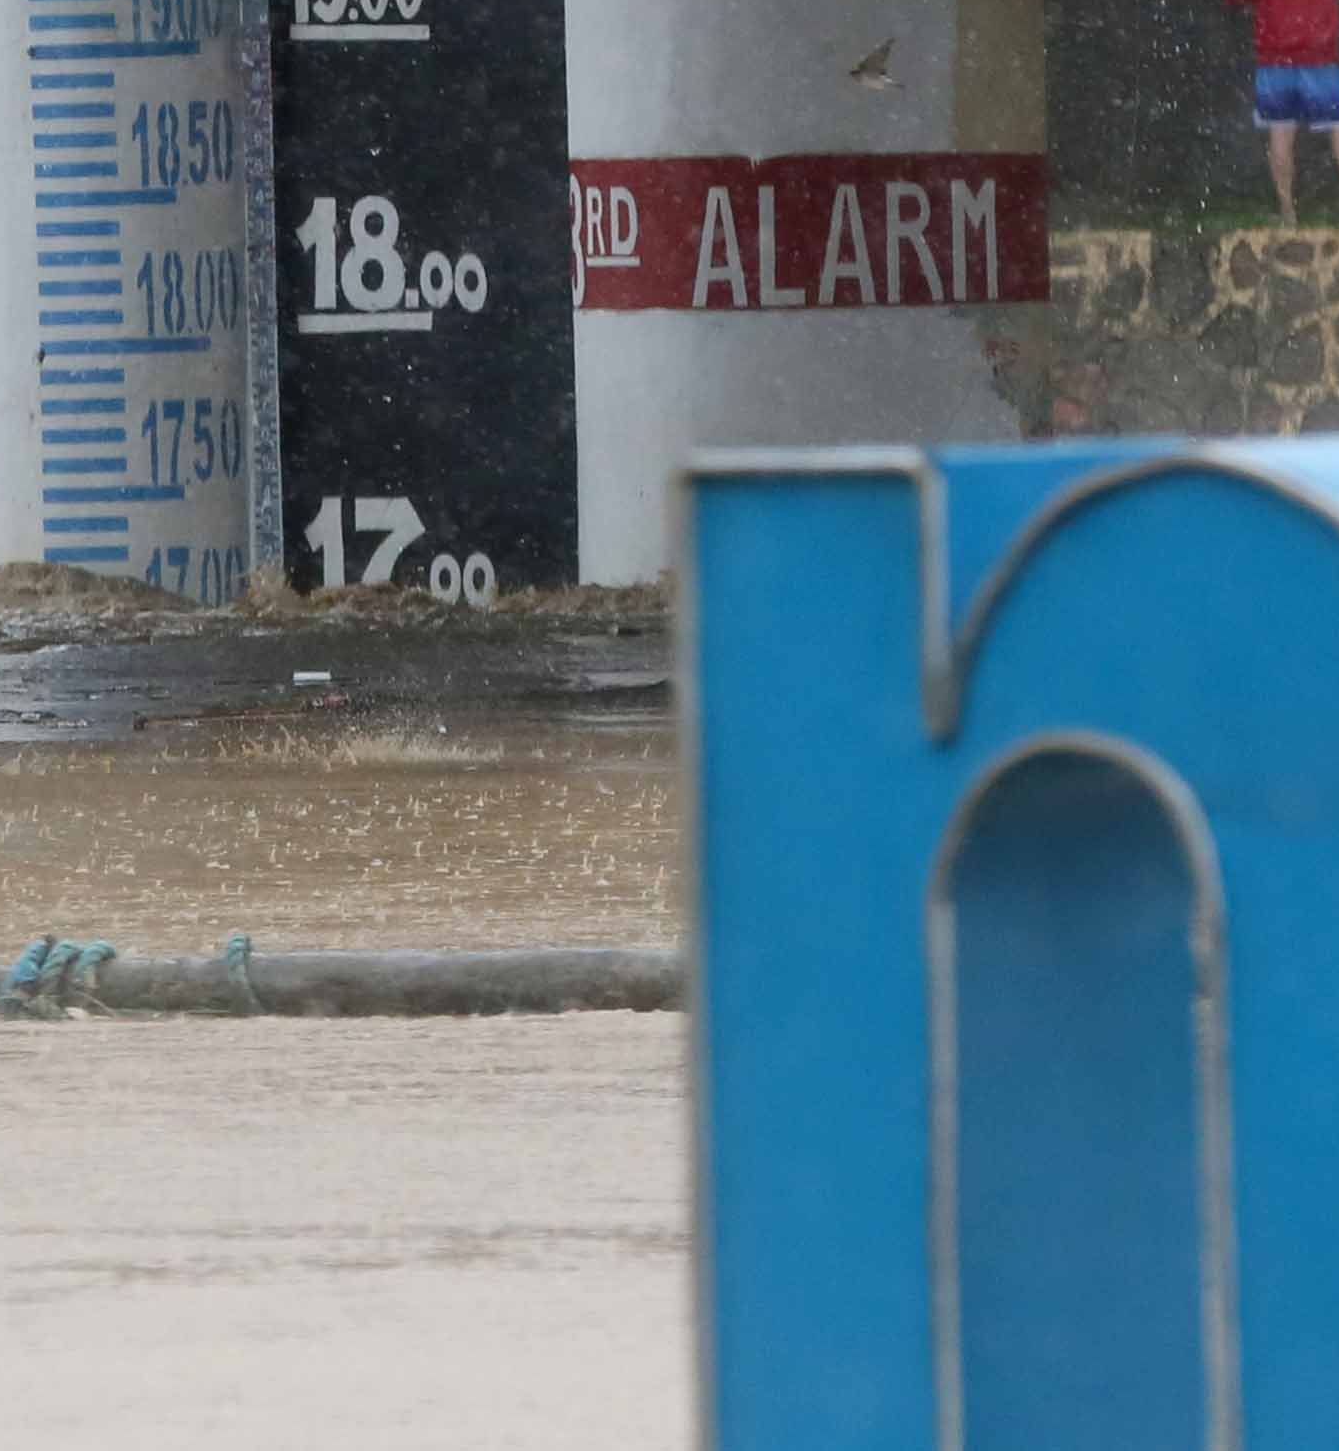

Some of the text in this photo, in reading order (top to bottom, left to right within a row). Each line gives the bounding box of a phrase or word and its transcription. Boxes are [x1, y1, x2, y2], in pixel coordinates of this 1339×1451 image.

[296, 195, 488, 312] 18.00
[692, 178, 1000, 309] ALARM
[303, 496, 496, 607] 1700
